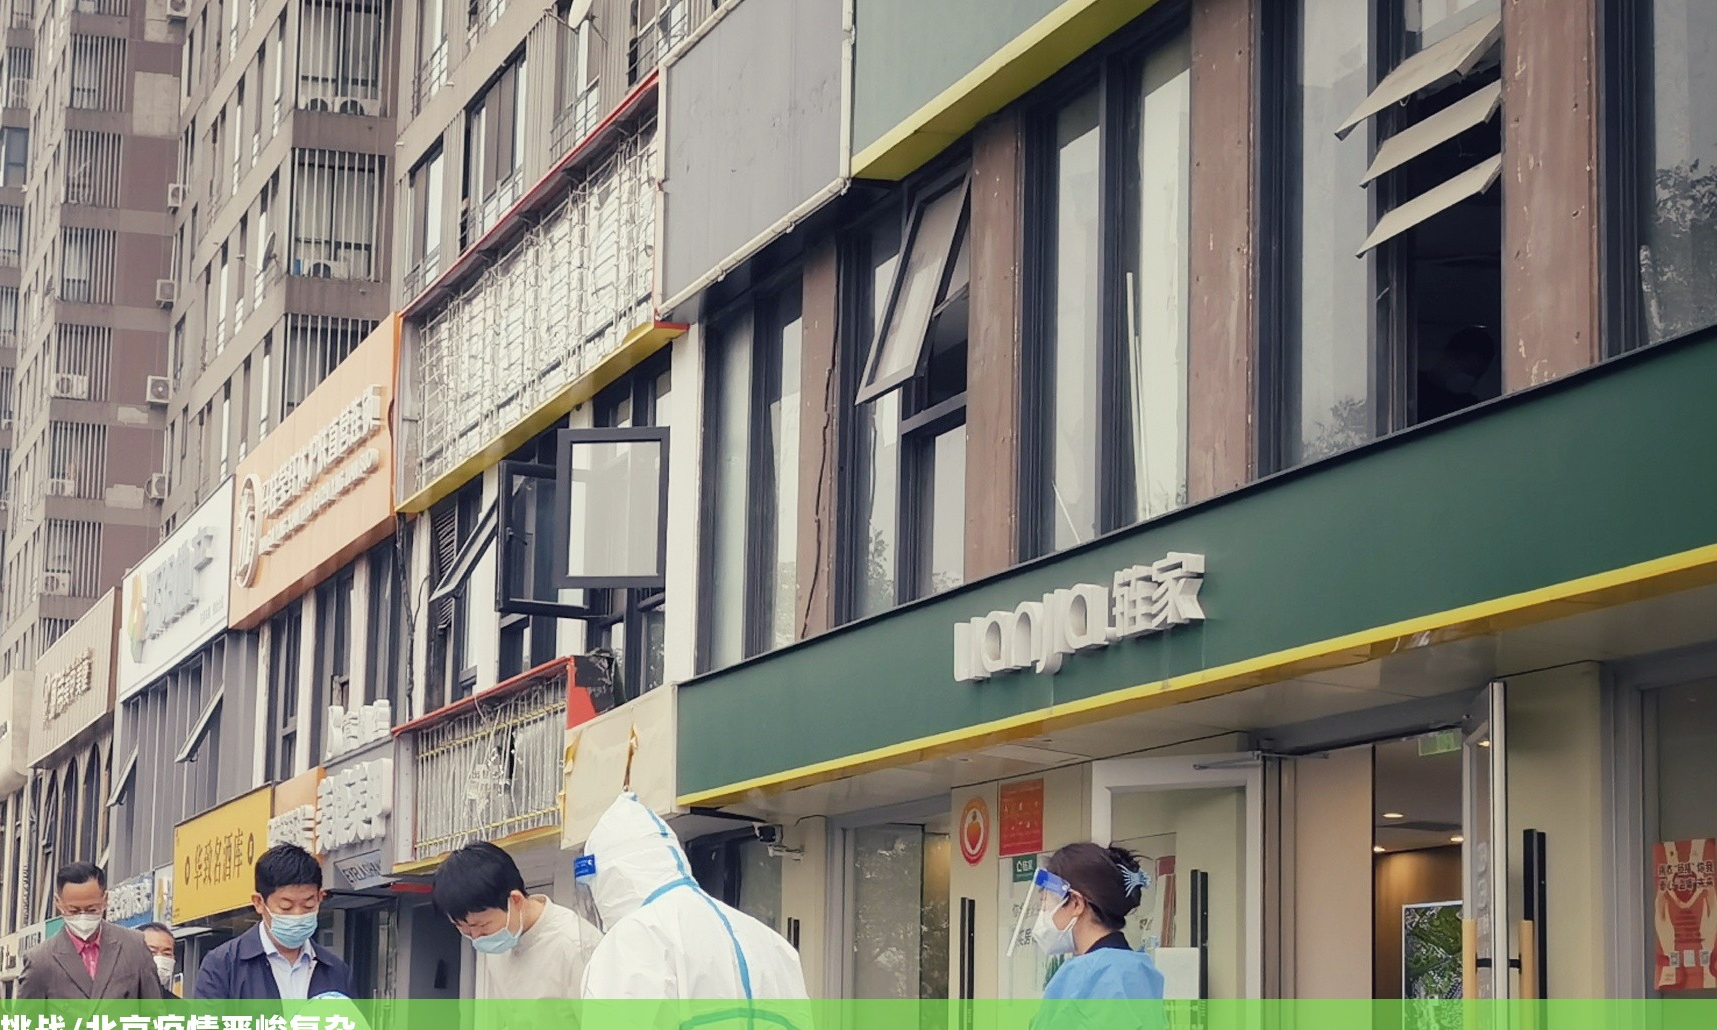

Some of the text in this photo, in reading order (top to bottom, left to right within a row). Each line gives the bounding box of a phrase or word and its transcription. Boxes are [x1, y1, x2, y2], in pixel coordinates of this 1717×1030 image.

[1112, 552, 1206, 638] 链家
[193, 828, 244, 890] 华致名酒库
